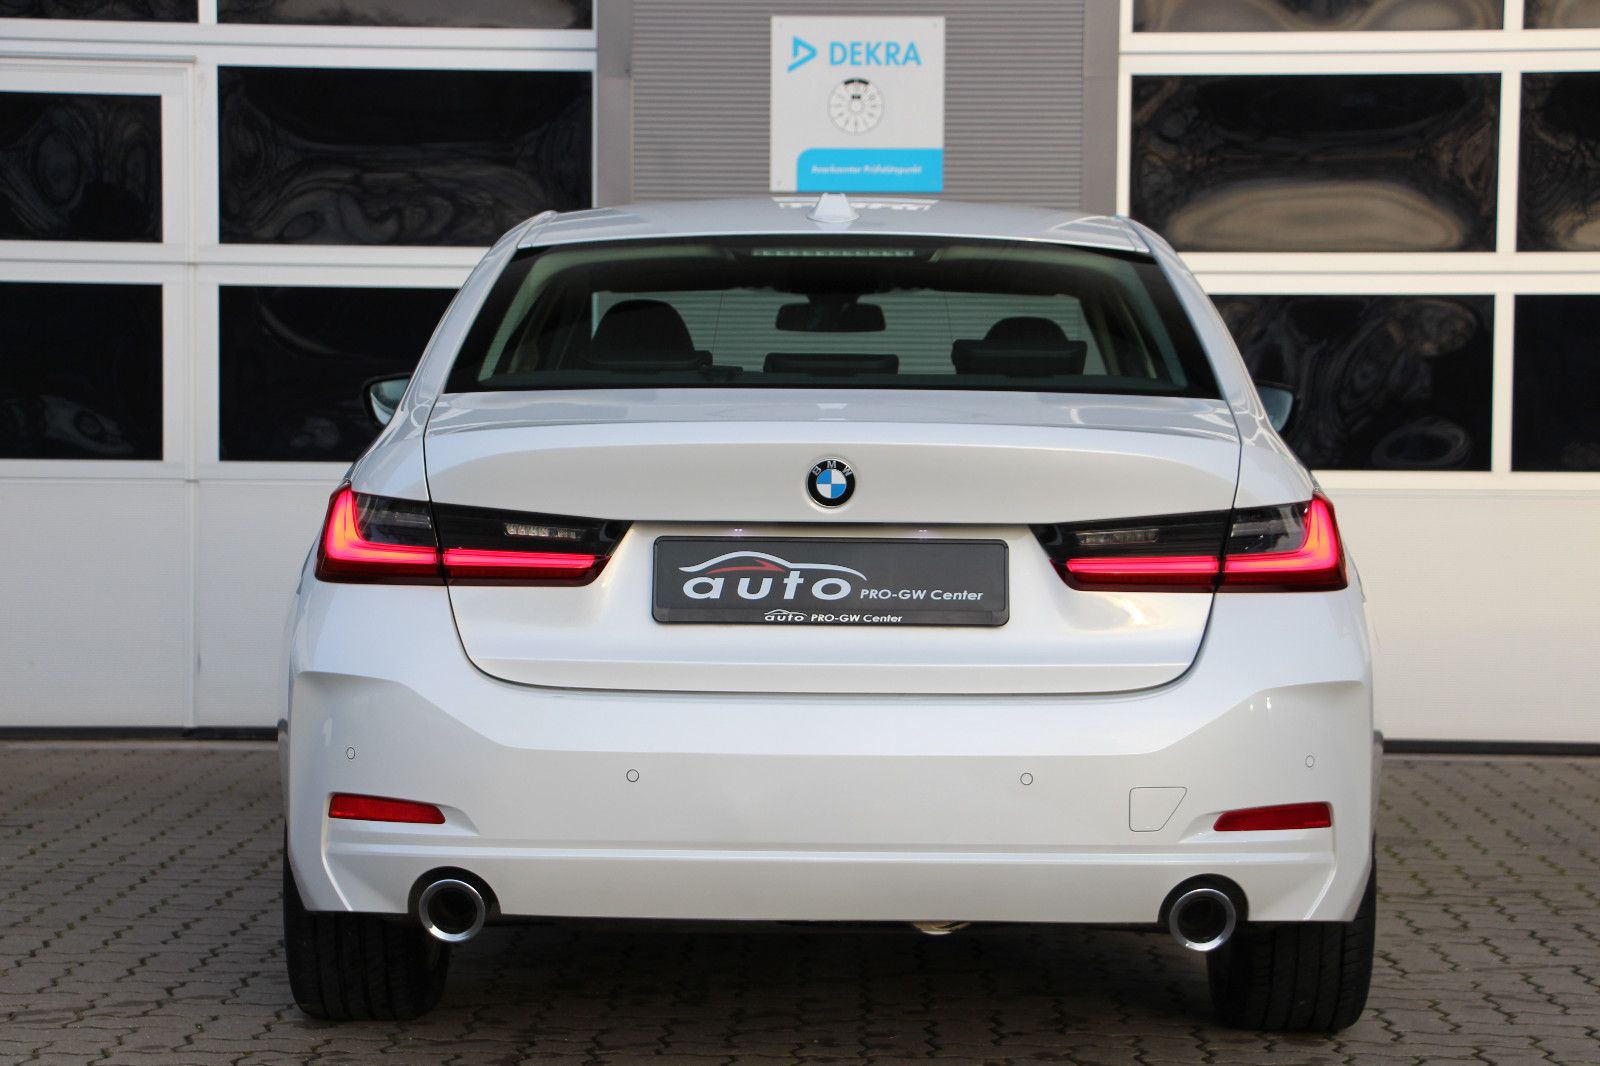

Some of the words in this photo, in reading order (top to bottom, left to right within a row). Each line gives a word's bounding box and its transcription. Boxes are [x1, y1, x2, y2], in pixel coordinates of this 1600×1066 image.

[829, 41, 922, 66] DEKRA
[812, 460, 852, 476] BMW
[683, 571, 851, 601] auto
[860, 589, 926, 600] PRO-GW
[930, 590, 983, 601] Center
[764, 613, 805, 622] auto
[811, 614, 860, 622] PRO-GW
[863, 614, 903, 623] Center
